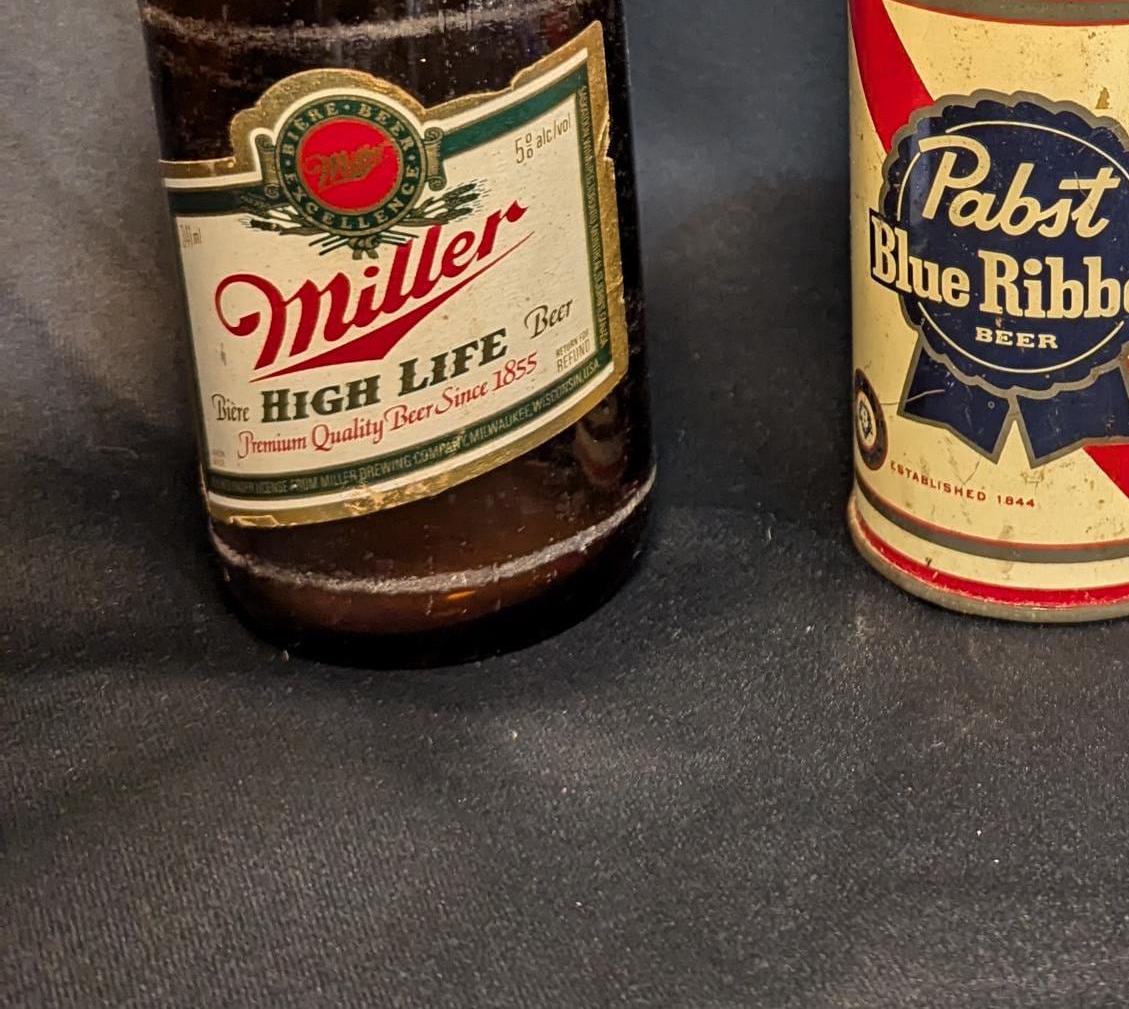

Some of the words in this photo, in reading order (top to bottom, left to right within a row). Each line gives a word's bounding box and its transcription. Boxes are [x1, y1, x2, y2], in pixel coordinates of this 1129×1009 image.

[358, 103, 415, 152] BEER
[536, 112, 571, 149] alc/vol
[284, 166, 420, 229] EXCELLENCE
[918, 134, 1121, 238] Pabst
[215, 200, 529, 370] Miller
[871, 216, 971, 308] Blue
[524, 299, 573, 339] Beer
[975, 326, 1059, 350] BEER
[211, 393, 249, 422] Bière
[261, 375, 381, 423] HIGH
[397, 328, 508, 396] LIFE
[557, 338, 590, 373] REFUND
[237, 430, 308, 459] Premium
[311, 417, 385, 451] Quality
[384, 404, 434, 431] Beer
[434, 381, 489, 415] Since
[493, 351, 538, 391] 1855
[319, 470, 358, 488] MILLER
[359, 454, 412, 481] BREWING
[890, 460, 986, 502] ESTABLISHED
[997, 494, 1035, 508] 1844
